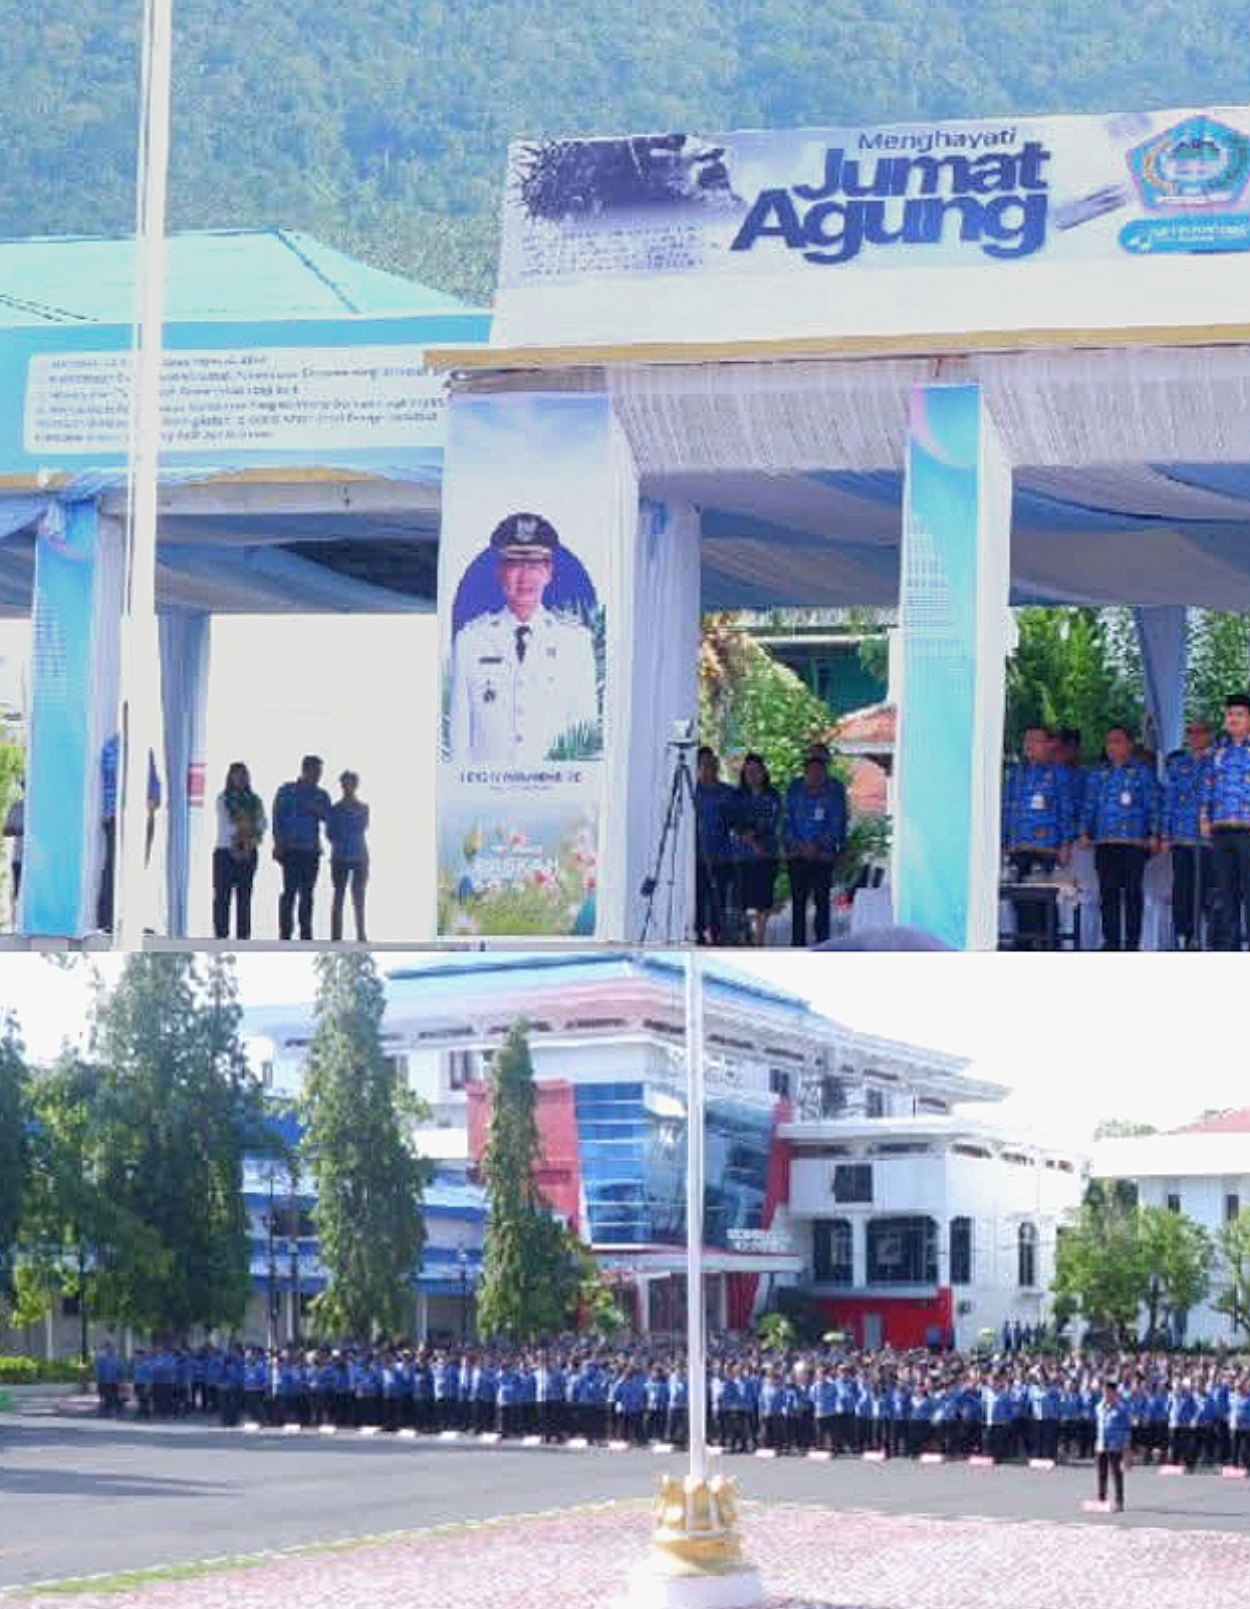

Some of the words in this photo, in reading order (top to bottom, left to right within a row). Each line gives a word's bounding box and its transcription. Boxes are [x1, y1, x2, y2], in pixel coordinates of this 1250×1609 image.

[858, 127, 1018, 153] Menghayati
[794, 141, 1051, 200] Jumat
[730, 186, 1050, 264] Agung
